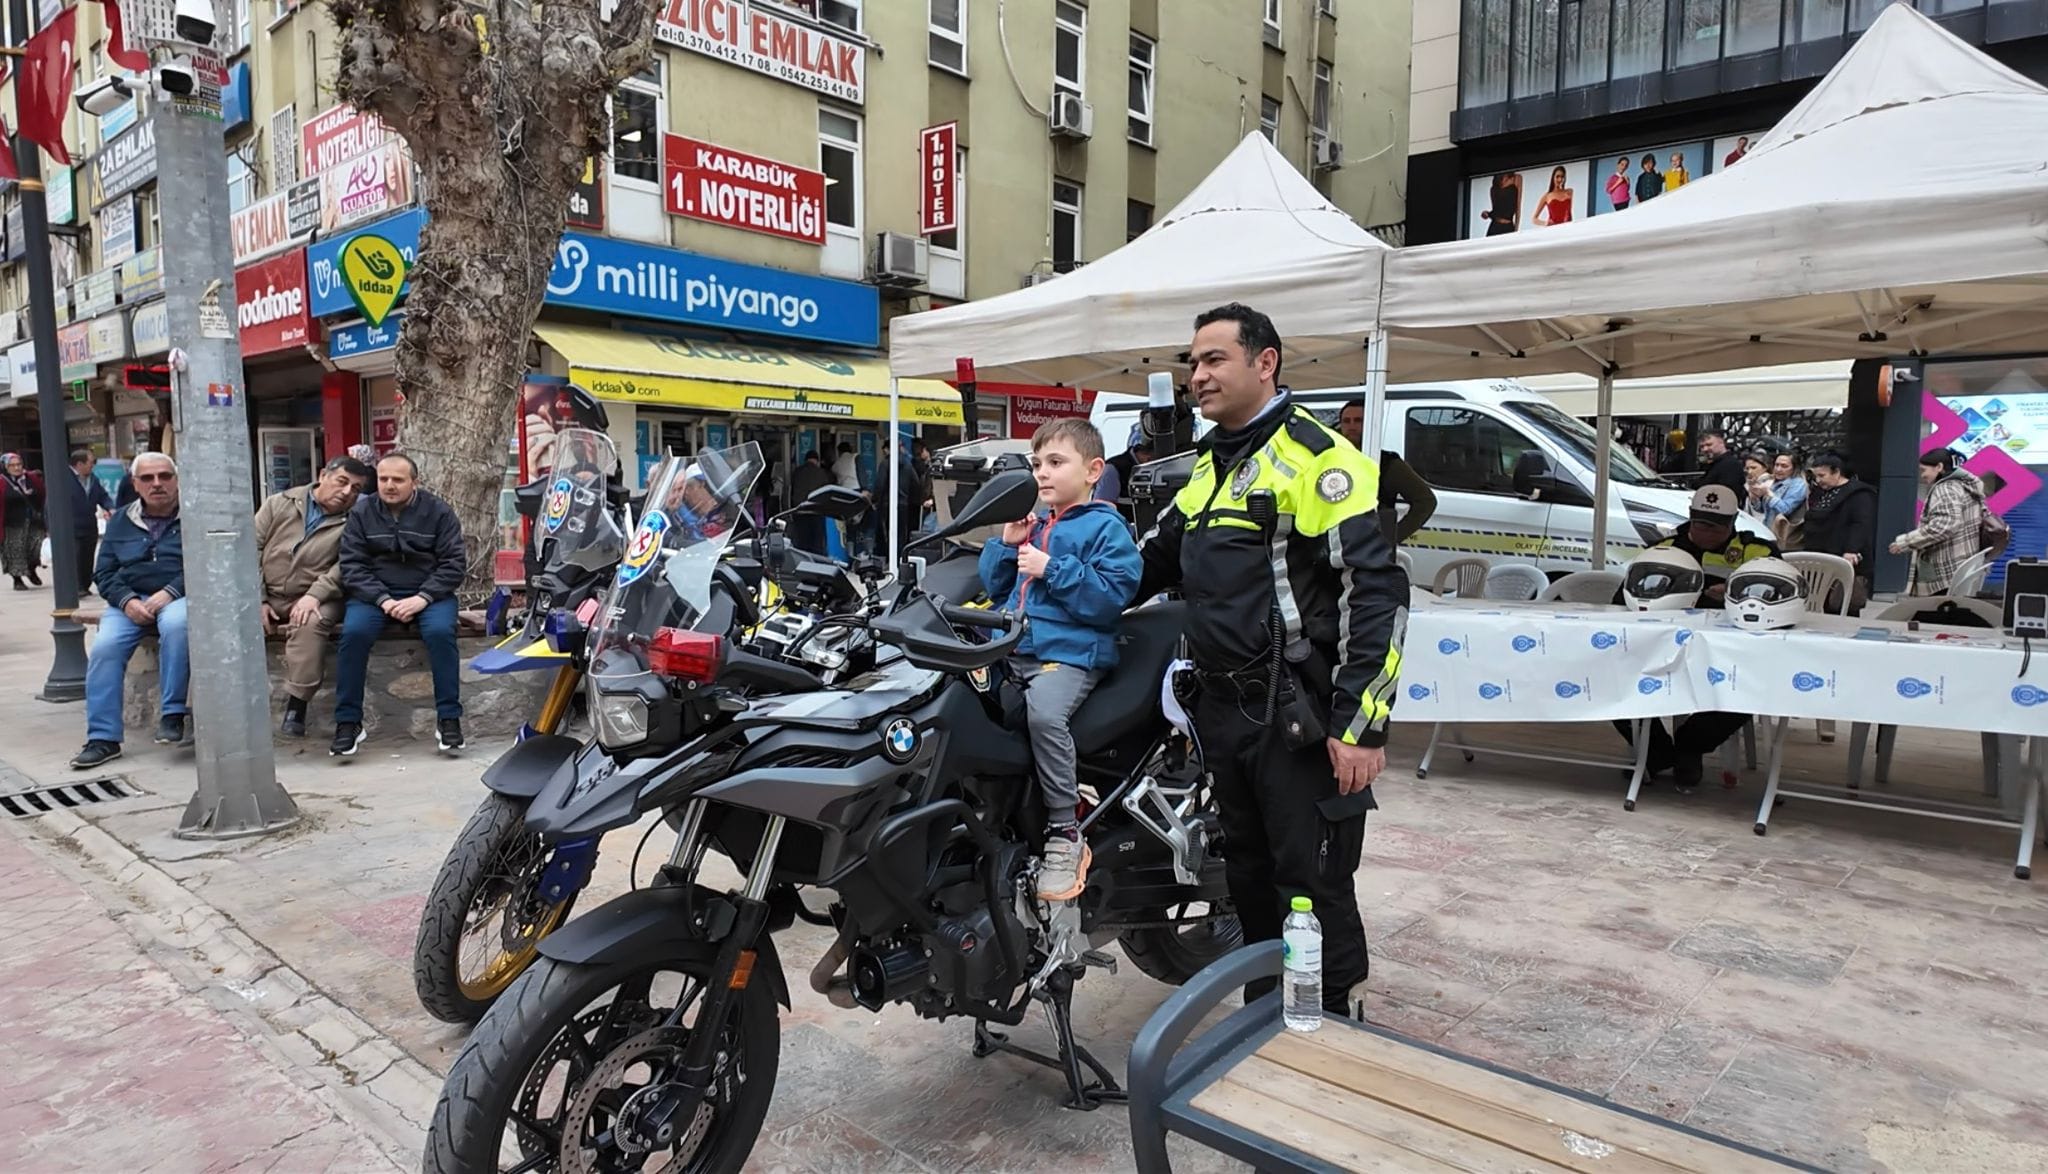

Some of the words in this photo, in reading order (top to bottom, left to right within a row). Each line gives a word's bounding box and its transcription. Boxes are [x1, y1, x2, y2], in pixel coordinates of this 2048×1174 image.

[750, 11, 858, 86] EMLAK
[741, 52, 754, 65] 17
[757, 57, 771, 72] 08
[780, 65, 829, 91] 0542.253
[831, 83, 844, 96] 41
[846, 87, 859, 100] 09
[115, 119, 156, 167] EMLAK
[697, 148, 798, 190] KARABÜK
[342, 186, 386, 214] KUAFÖR
[671, 172, 694, 212] 1.
[701, 180, 821, 239] NOTERLİĞİ
[250, 196, 288, 250] EMLAK
[359, 279, 394, 295] iddaa
[597, 261, 678, 302] milli
[685, 274, 819, 328] piyango
[591, 380, 622, 394] iddaa
[637, 387, 661, 397] com
[1017, 397, 1042, 411] Uygun
[1515, 542, 1534, 550] OLAY
